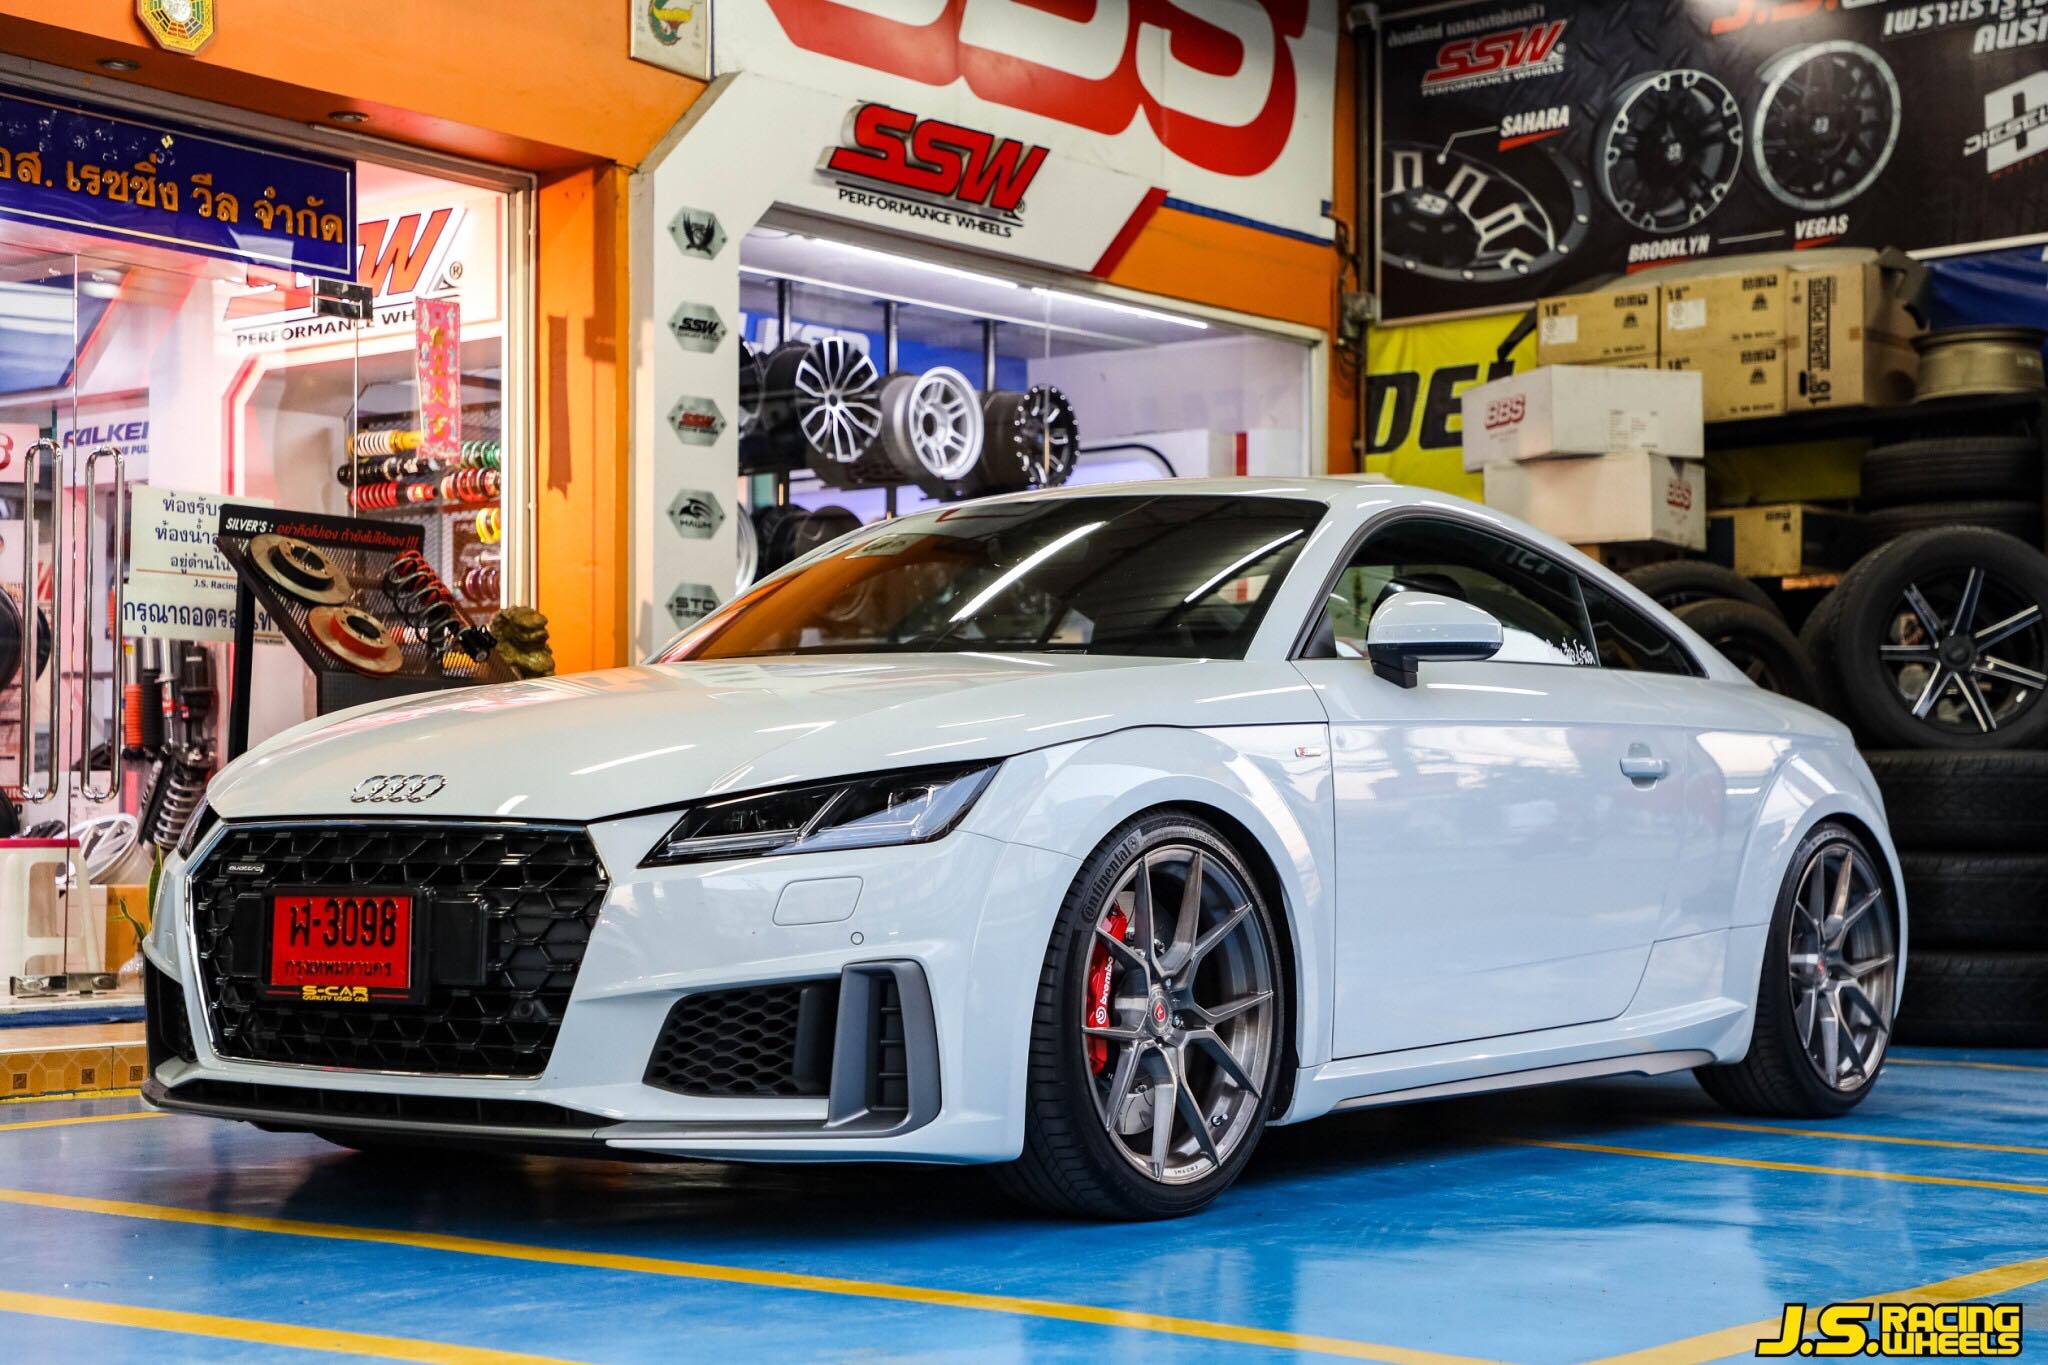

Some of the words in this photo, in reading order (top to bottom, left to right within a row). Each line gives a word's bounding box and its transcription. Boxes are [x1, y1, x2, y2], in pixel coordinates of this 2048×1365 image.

[1422, 19, 1567, 84] SSW
[1500, 105, 1570, 138] SAHARA
[826, 102, 1051, 212] SSW
[66, 152, 179, 212] เรซซิ่ง
[190, 173, 239, 223] วีล
[254, 186, 344, 244] จำกัด
[838, 187, 951, 225] PERFORMANCE
[956, 213, 1012, 238] WHEELS
[1795, 215, 1849, 240] VEGAS
[1628, 234, 1710, 263] BROOKLYN
[678, 317, 718, 335] SSW
[1485, 394, 1526, 429] BBS
[163, 493, 222, 517] ห้องรับ
[225, 517, 268, 533] SILVER'S
[211, 580, 237, 592] Racin
[676, 596, 716, 610] STD
[228, 864, 265, 873] quattro
[1081, 841, 1133, 923] Continental
[302, 985, 369, 996] S-CAR
[1100, 956, 1114, 1005] brembo
